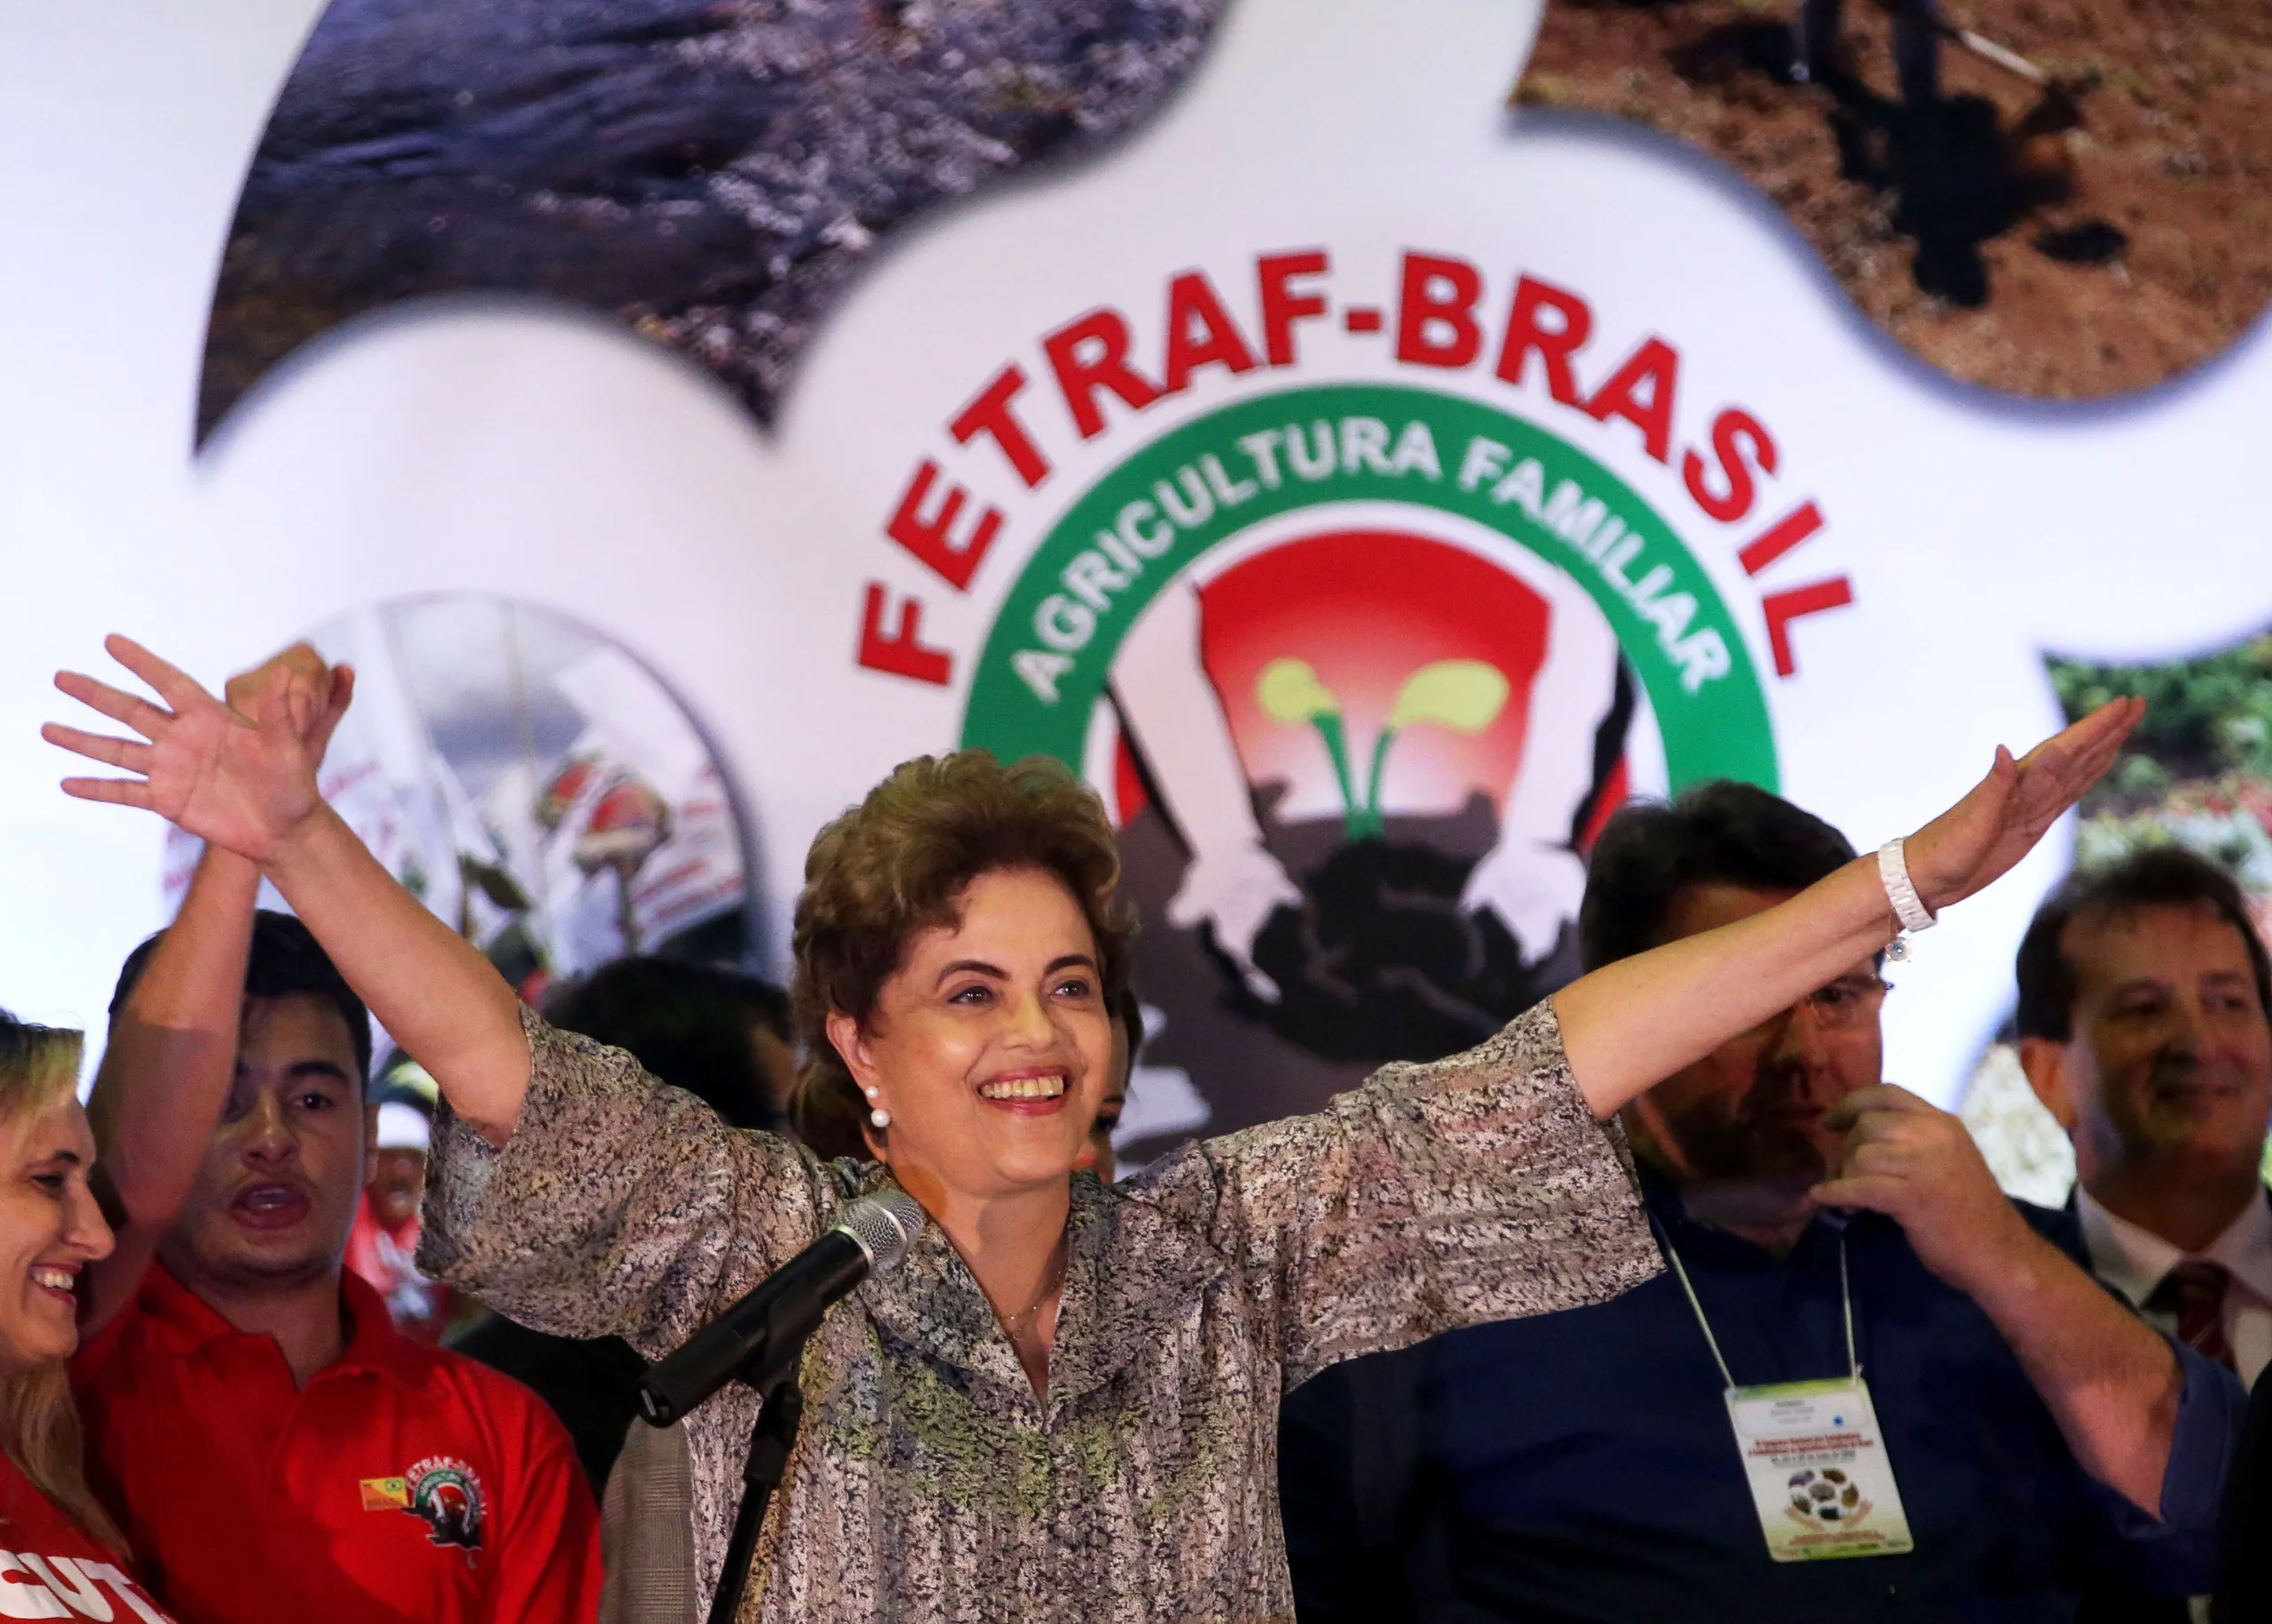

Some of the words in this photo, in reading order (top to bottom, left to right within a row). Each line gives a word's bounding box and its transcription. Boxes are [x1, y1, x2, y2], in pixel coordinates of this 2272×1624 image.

[857, 251, 1853, 686] FETRAF-BRASIL
[1012, 417, 1443, 705] AGRICULTURA
[1457, 437, 1732, 692] FAMILIAR
[0, 1548, 170, 1624] CUT
